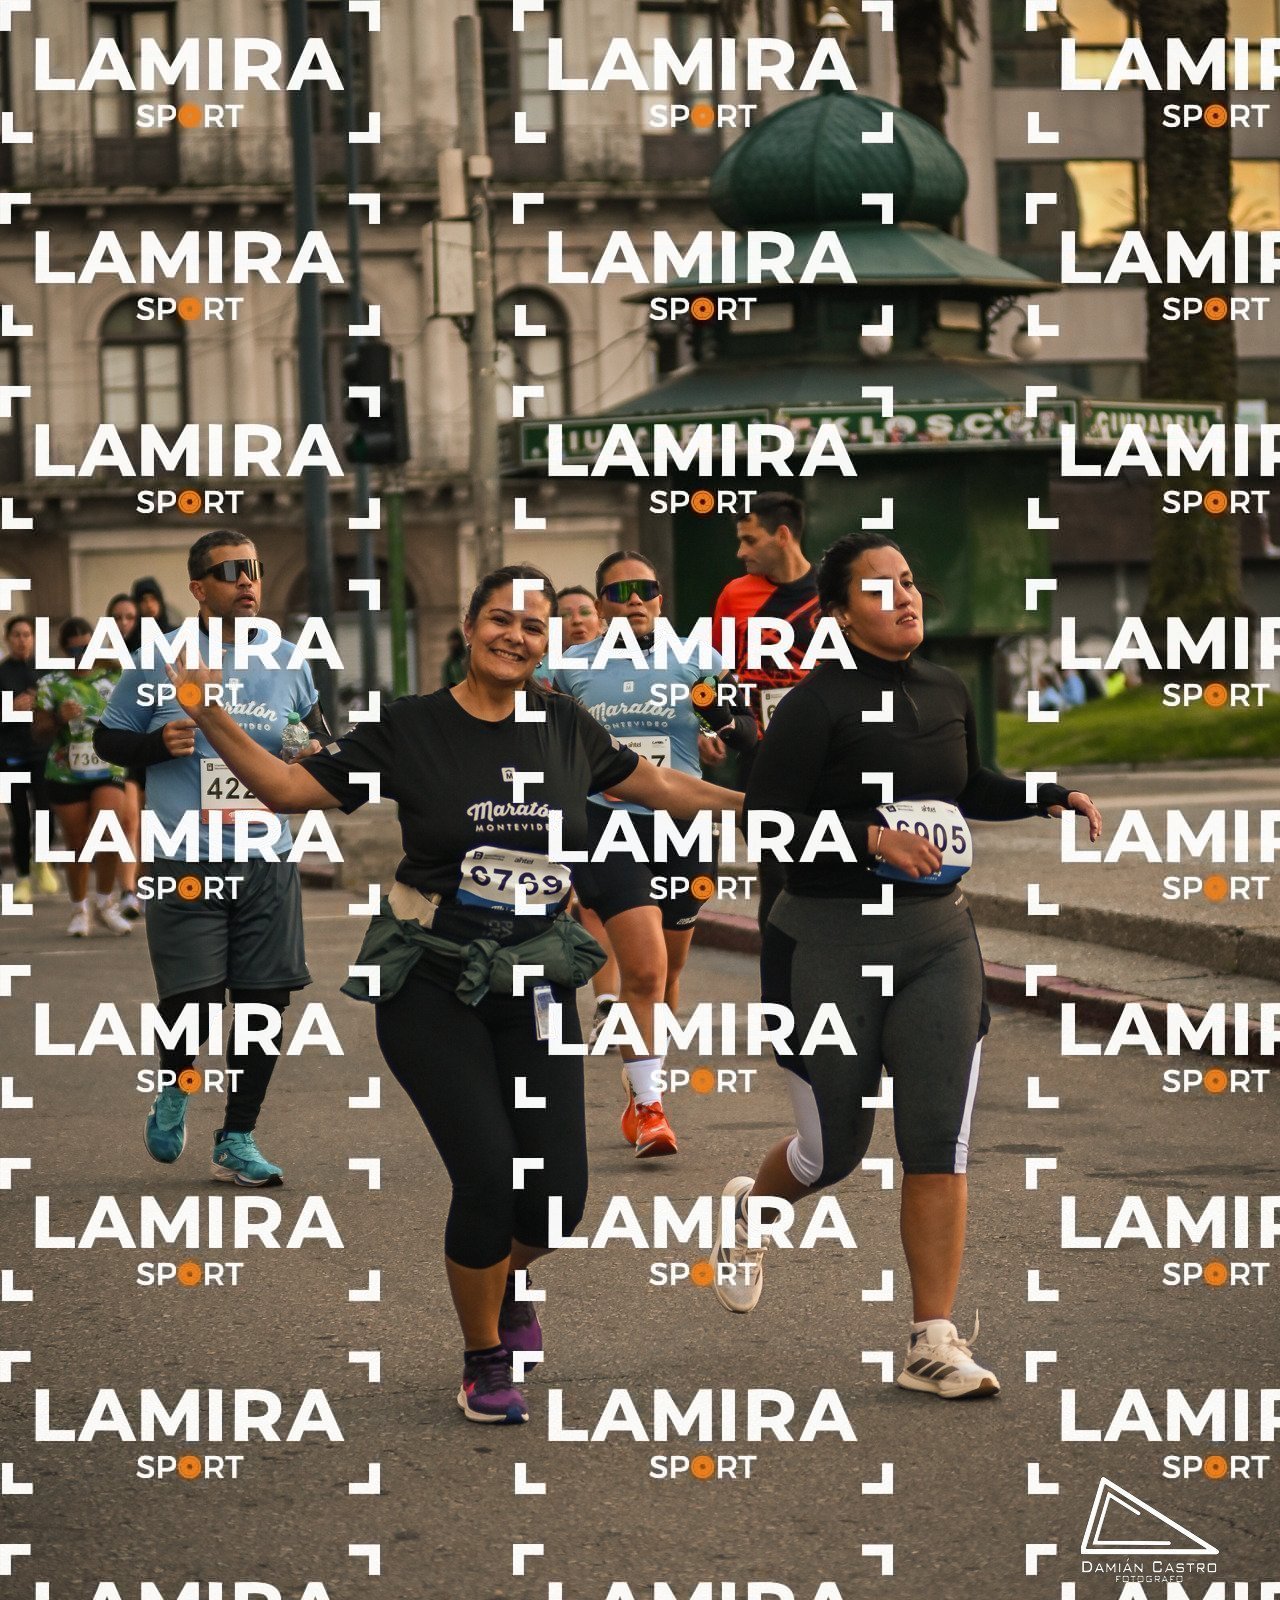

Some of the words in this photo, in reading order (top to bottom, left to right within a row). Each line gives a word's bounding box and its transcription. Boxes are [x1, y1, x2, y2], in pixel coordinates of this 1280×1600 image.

[603, 721, 668, 731] ONTEVIDEO
[466, 800, 563, 822] Marató
[475, 823, 549, 833] MONTEVIDE
[470, 866, 563, 896] 6769
